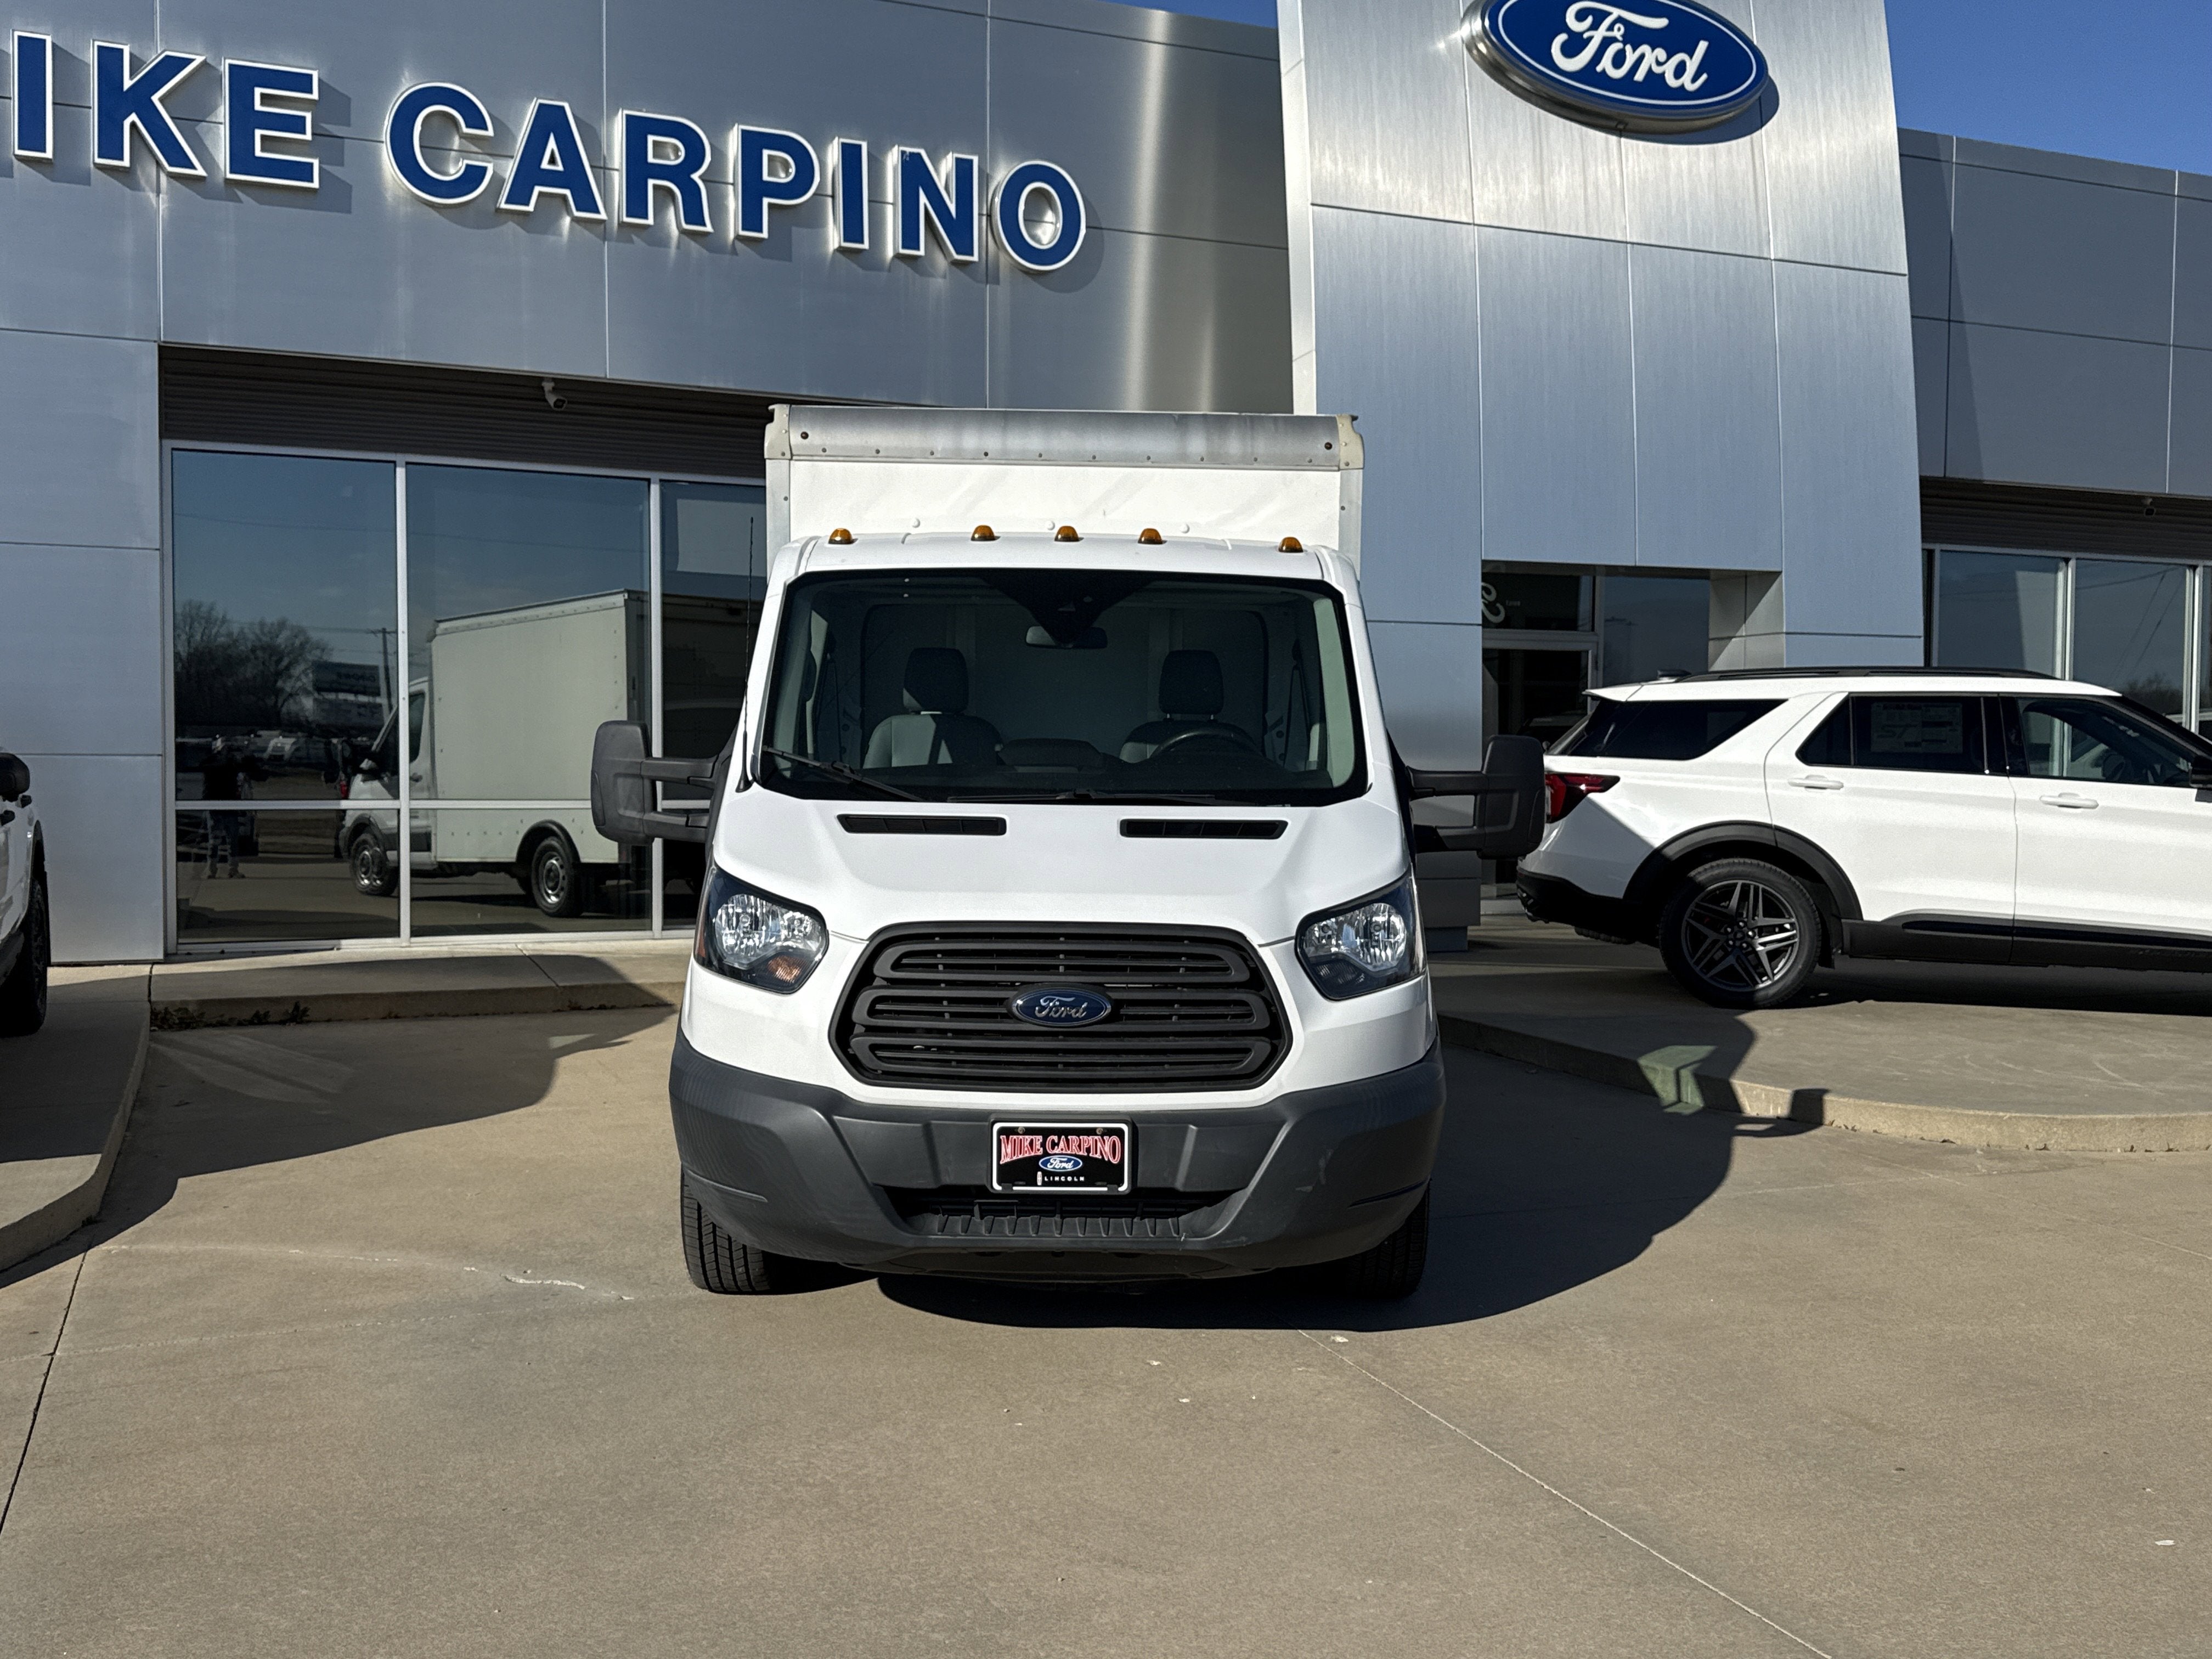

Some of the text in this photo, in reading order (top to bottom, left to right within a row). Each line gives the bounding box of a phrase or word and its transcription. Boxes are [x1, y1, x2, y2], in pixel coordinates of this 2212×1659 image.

[1551, 1, 1708, 92] Ford
[383, 82, 1086, 273] CARPINO
[1035, 995, 1088, 1019] Ford
[1000, 1135, 1121, 1164] MIKE CARPINO
[1047, 1157, 1074, 1169] Ford
